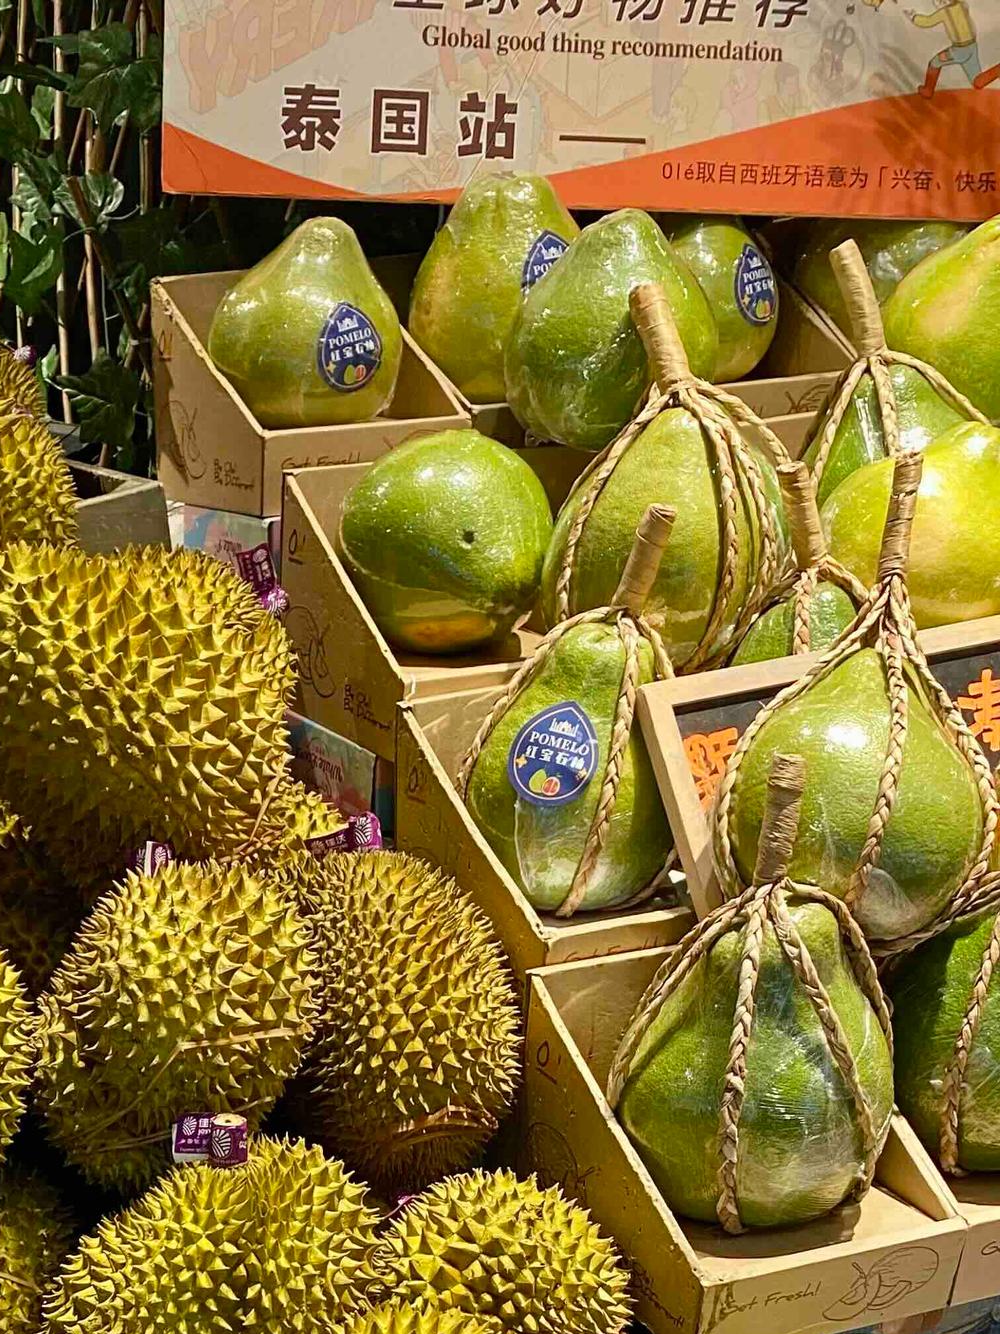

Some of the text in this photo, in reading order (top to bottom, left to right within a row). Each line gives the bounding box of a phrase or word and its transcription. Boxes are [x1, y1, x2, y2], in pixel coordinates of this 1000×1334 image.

[422, 24, 783, 63] Global good thing recommendation
[280, 83, 520, 160] 泰国站
[328, 326, 372, 350] POMELO
[529, 731, 590, 756] POMELO
